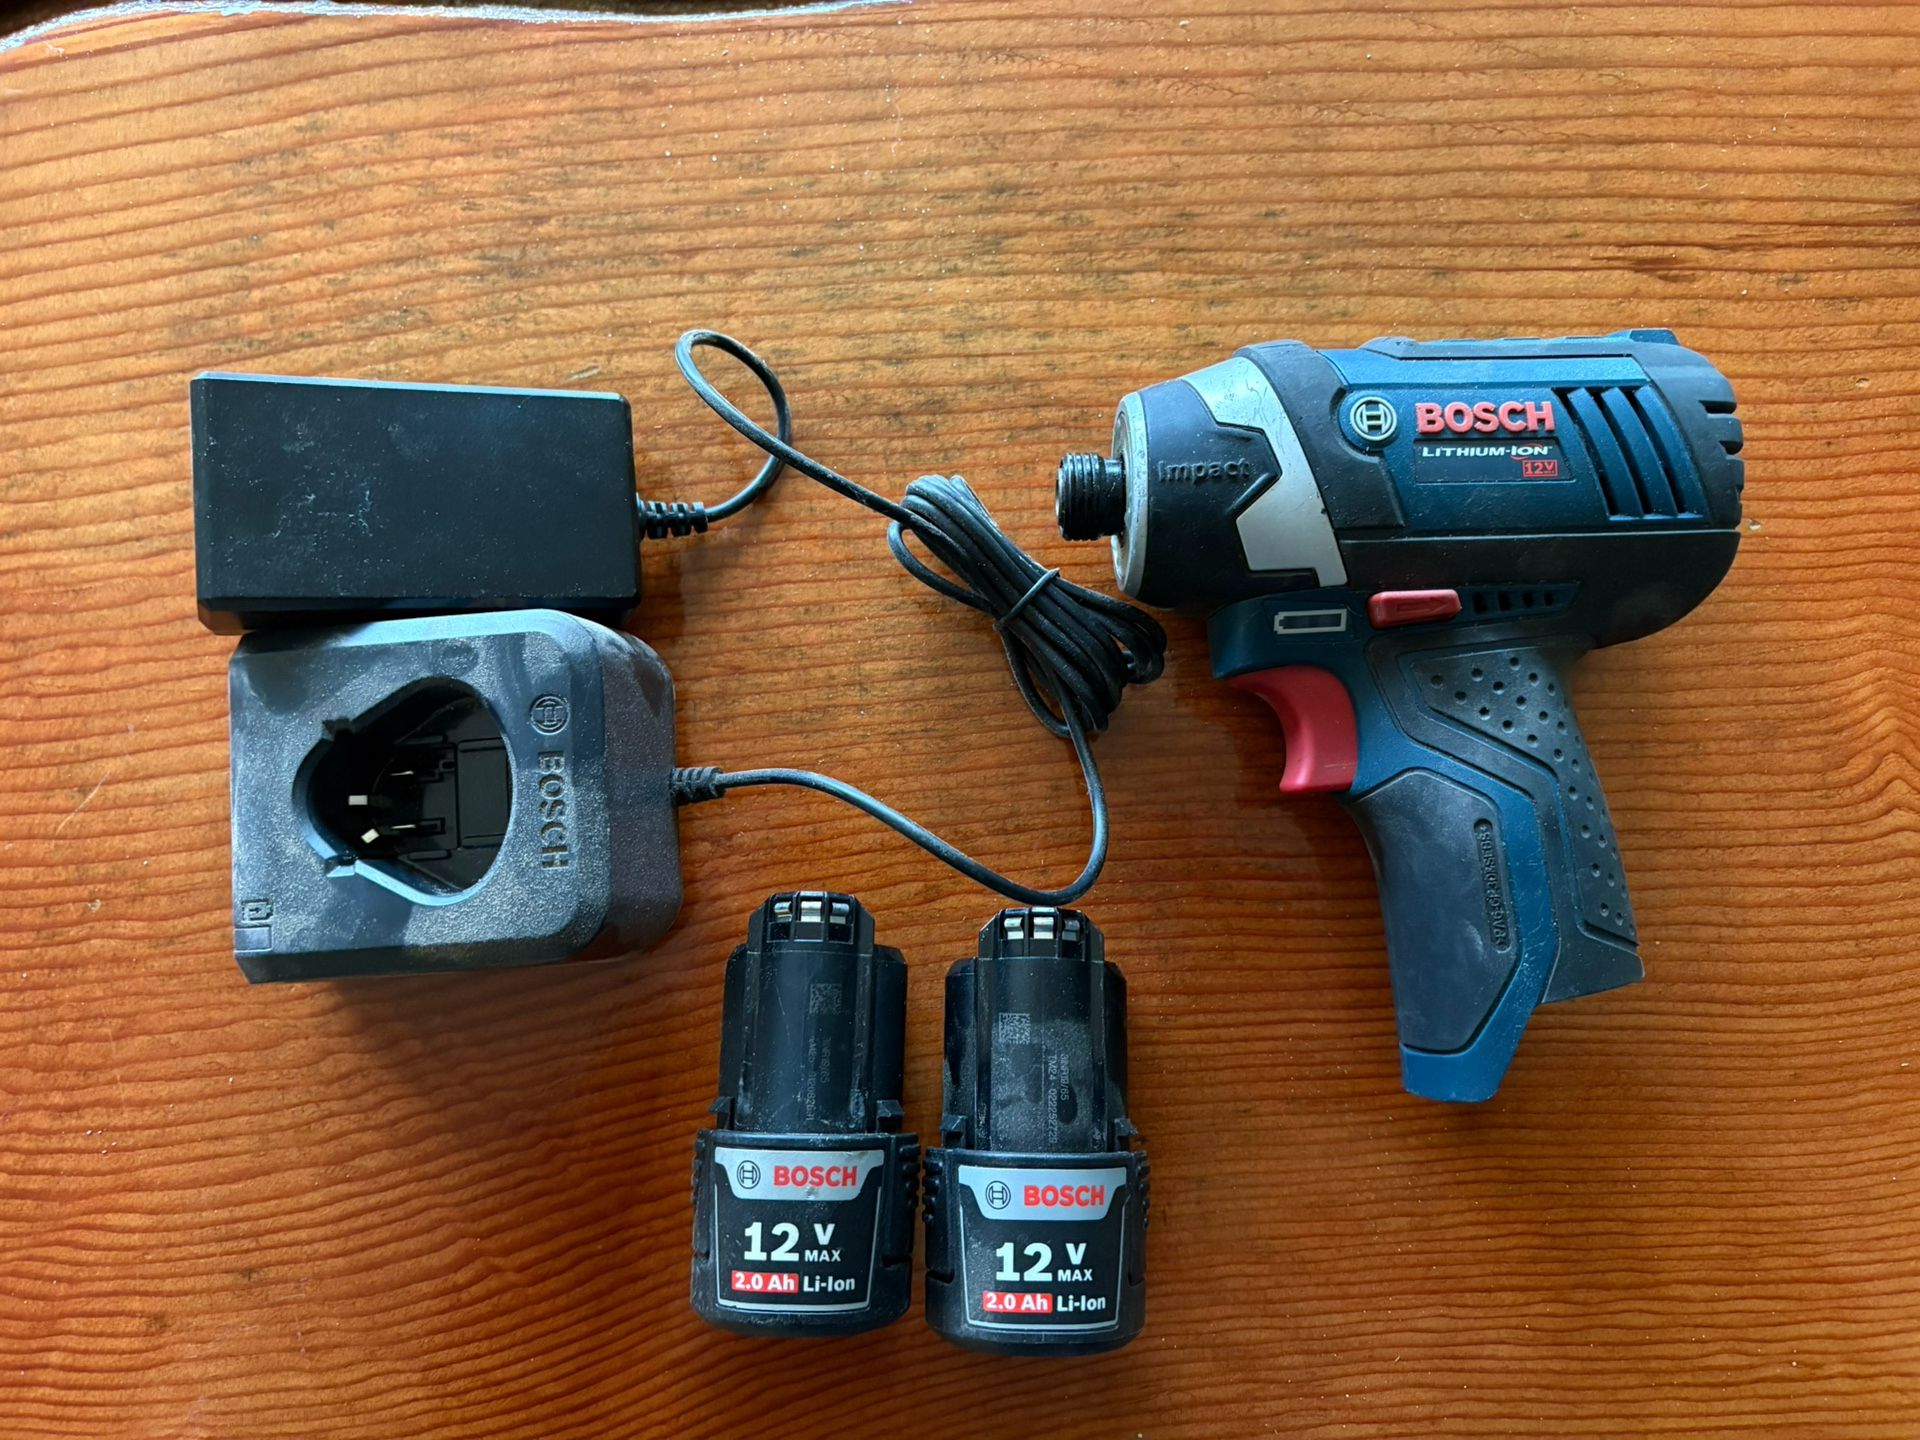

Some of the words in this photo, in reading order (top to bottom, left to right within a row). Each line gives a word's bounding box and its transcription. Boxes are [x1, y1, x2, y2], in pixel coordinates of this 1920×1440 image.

[1415, 401, 1555, 434] BOSCH
[1422, 445, 1549, 457] LITHIUM-ION
[1158, 458, 1249, 485] Impact
[538, 751, 570, 869] BOSCH
[774, 1165, 857, 1187] BOSCH
[1024, 1185, 1105, 1207] BOSCH
[744, 1222, 799, 1262] 12
[814, 1223, 835, 1245] V
[804, 1250, 841, 1262] MAX
[996, 1242, 1053, 1281] 12
[1065, 1243, 1087, 1265] V
[735, 1274, 763, 1290] 2.0
[768, 1274, 795, 1291] Ah
[803, 1276, 855, 1292] Li-Ion
[1057, 1269, 1093, 1281] MAX
[986, 1292, 1016, 1309] 2.0
[1021, 1293, 1048, 1310] Ah
[1057, 1295, 1106, 1312] Li-Ion
